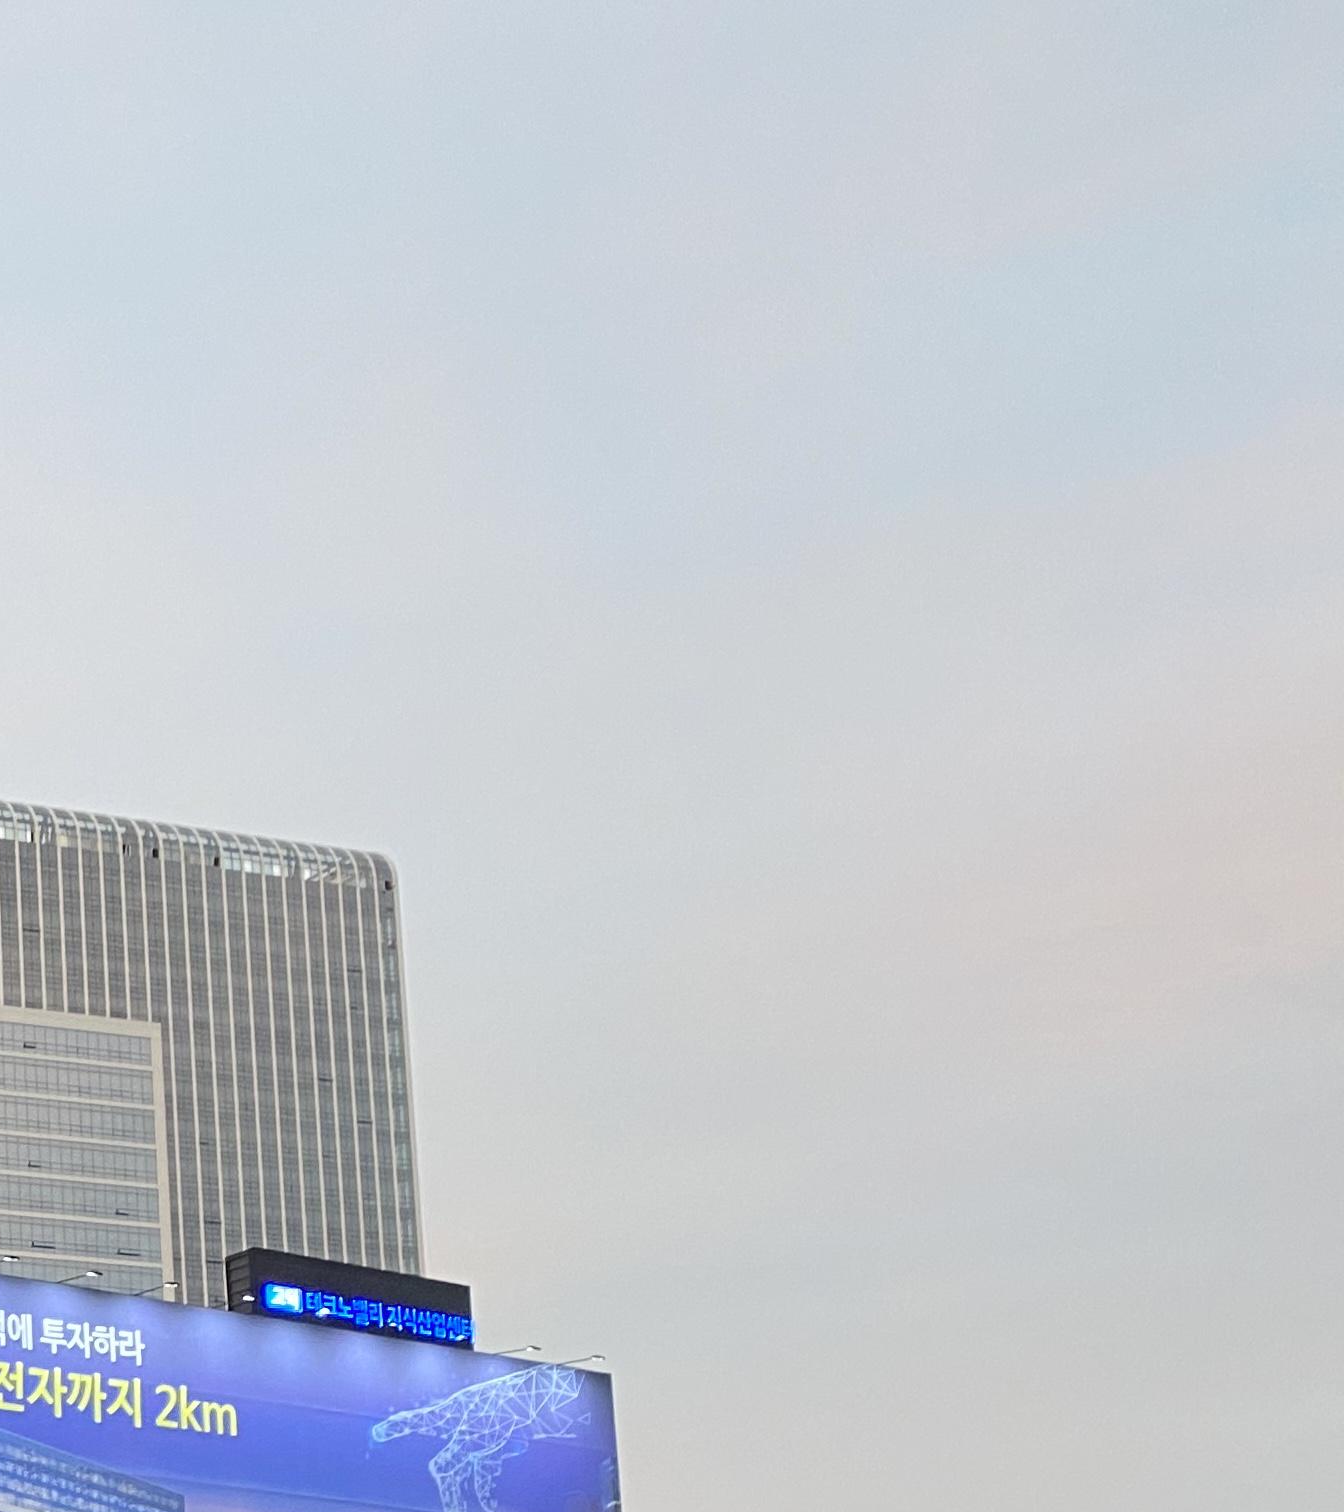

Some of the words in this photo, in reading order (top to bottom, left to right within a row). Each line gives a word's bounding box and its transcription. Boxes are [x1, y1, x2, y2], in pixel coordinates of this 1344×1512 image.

[40, 1317, 145, 1366] 투자하라
[306, 1292, 383, 1328] 테크노밸리
[386, 1305, 475, 1344] 지식산업센터
[155, 1385, 238, 1437] 2km
